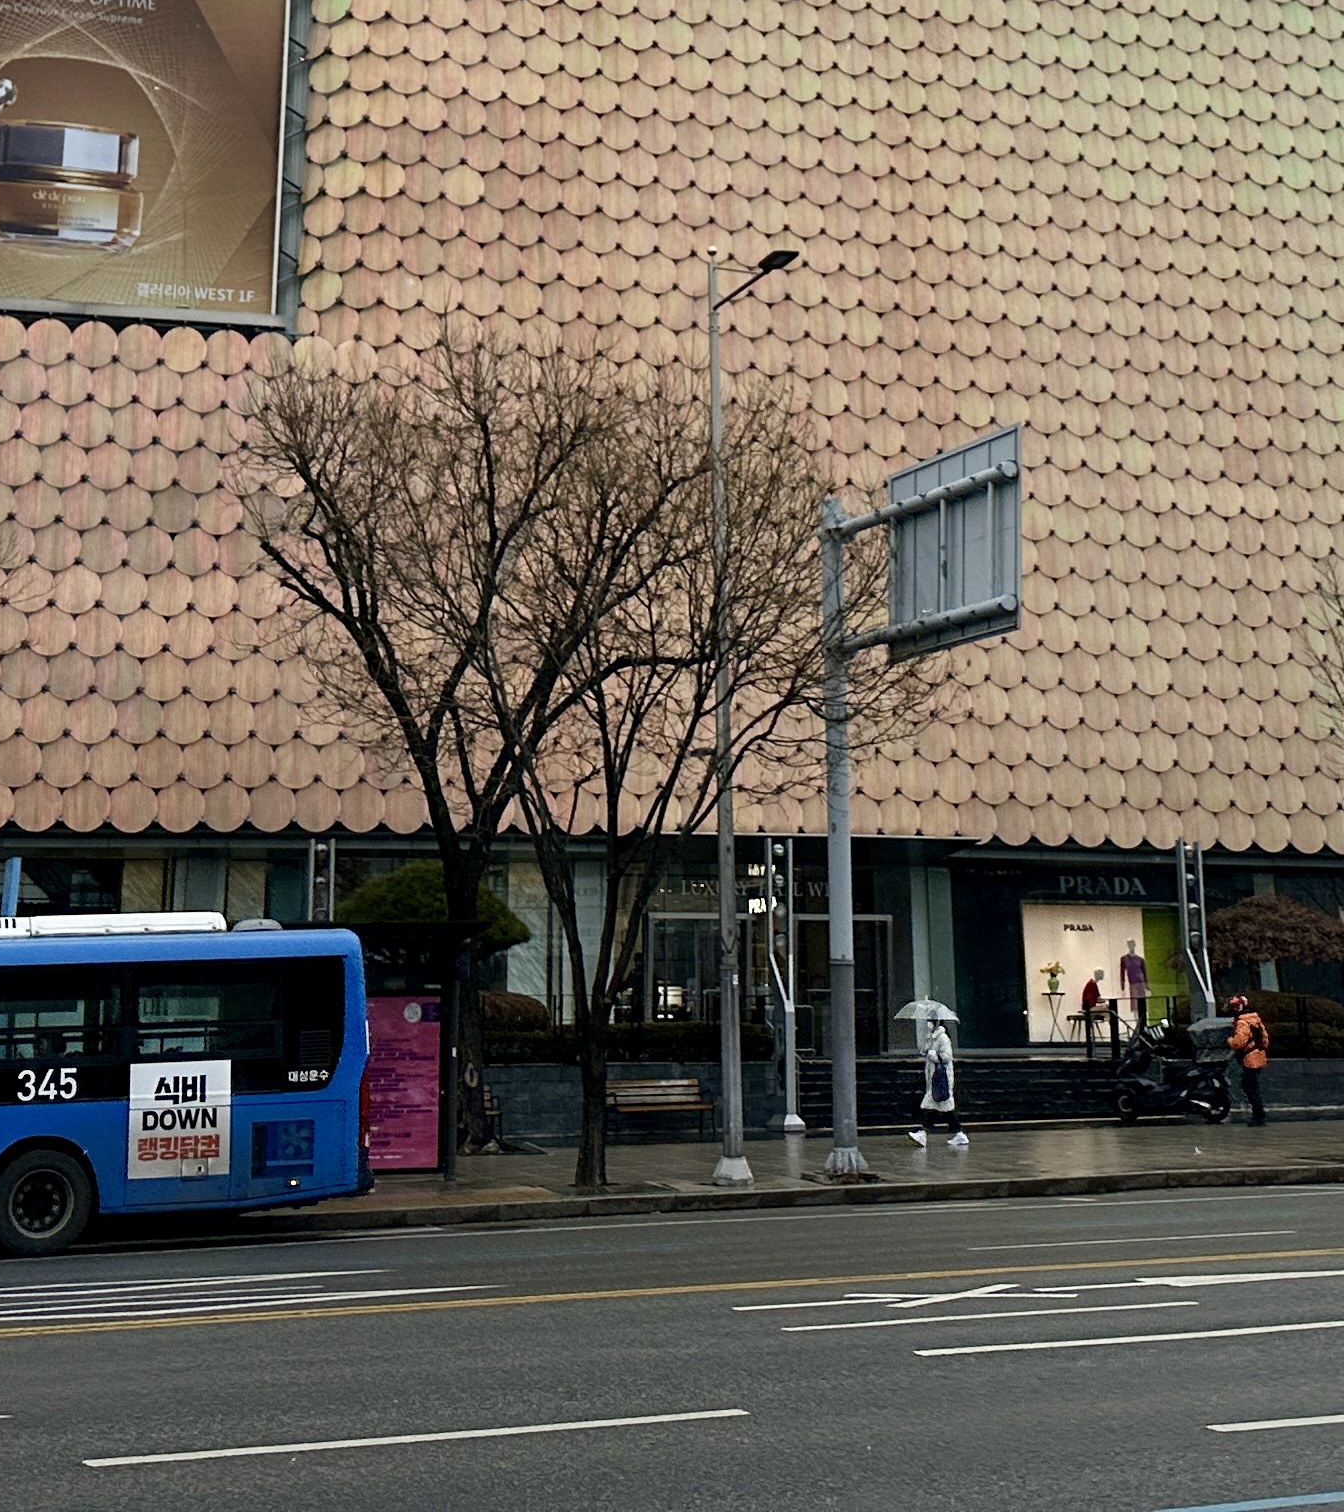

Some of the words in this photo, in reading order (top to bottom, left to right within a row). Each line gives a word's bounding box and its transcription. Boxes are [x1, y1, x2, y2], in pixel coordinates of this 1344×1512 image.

[98, 12, 144, 25] Supreme
[137, 282, 191, 300] 갤러리아
[195, 287, 234, 302] WEST
[238, 289, 255, 303] 1F
[1058, 875, 1147, 896] PRADA
[1063, 923, 1094, 932] PRADA
[17, 1067, 78, 1101] 345
[288, 1069, 330, 1082] 대성운수
[154, 1074, 207, 1105] 식비
[142, 1107, 218, 1131] DOWN
[137, 1134, 220, 1161] 랭킹닭컴
